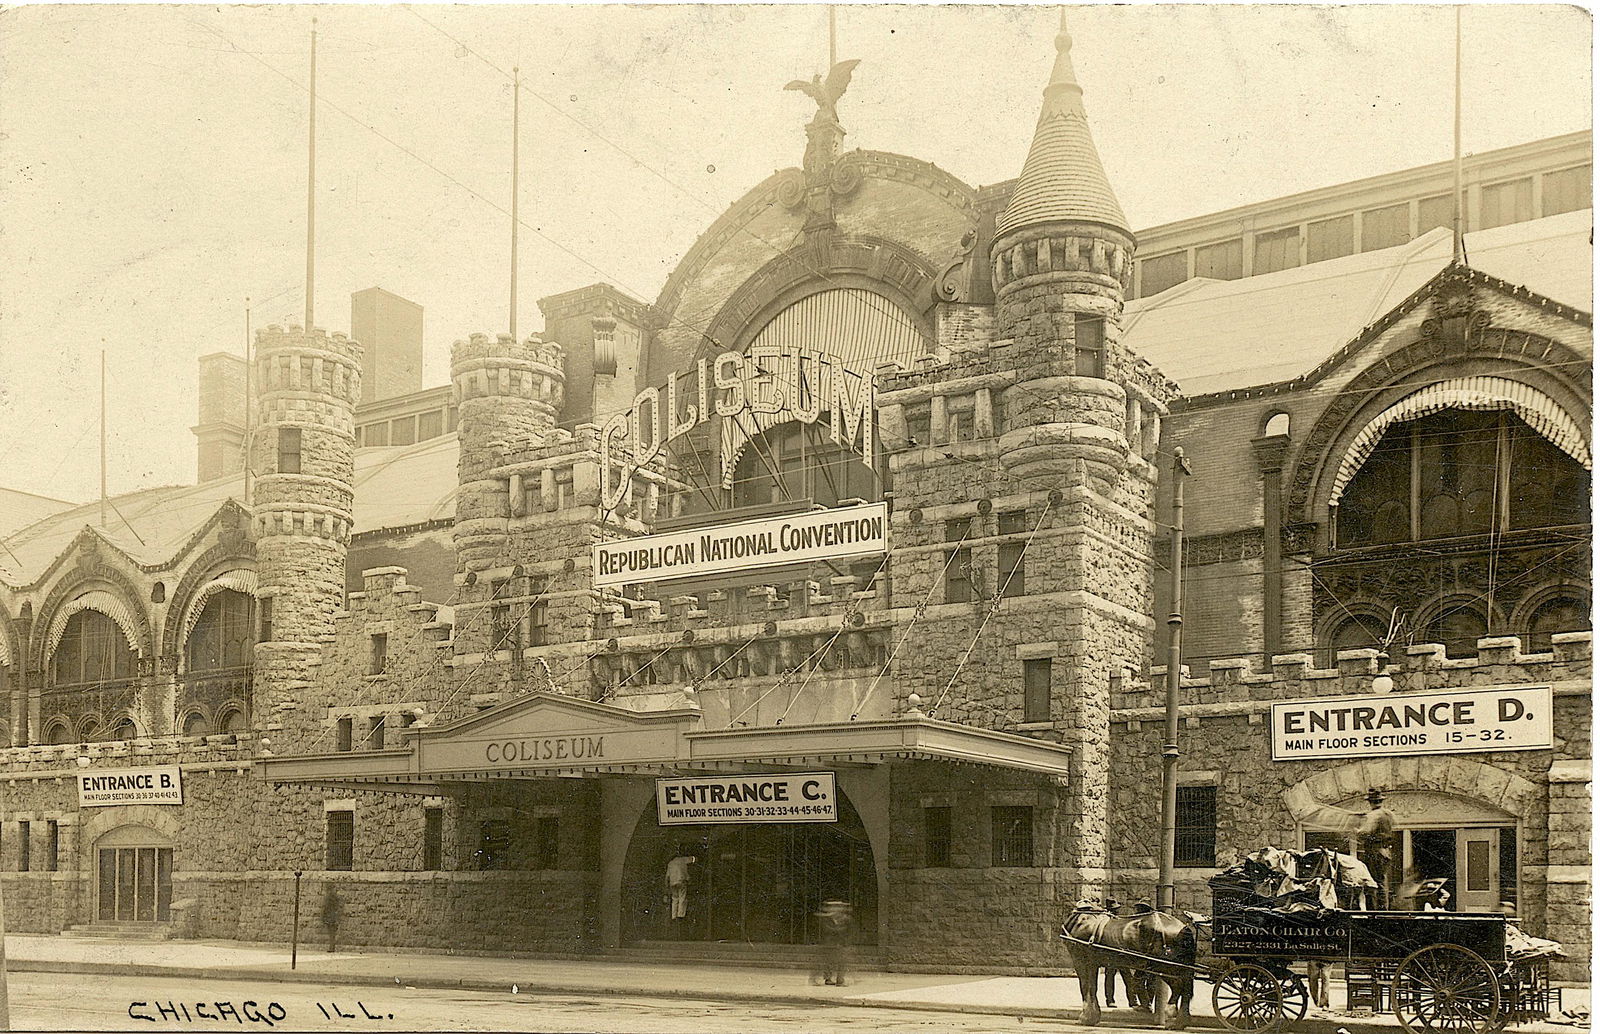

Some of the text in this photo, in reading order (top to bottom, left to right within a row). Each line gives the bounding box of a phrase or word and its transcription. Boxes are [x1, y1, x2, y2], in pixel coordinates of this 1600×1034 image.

[601, 346, 876, 511] COLISEUM
[599, 516, 882, 576] REPUBLICAN NATIONAL CONVENTION
[1283, 698, 1534, 734] ENTRANCE D.
[486, 736, 605, 763] COLISEUM
[1285, 739, 1313, 751] MAIN
[1318, 737, 1358, 750] FLOOR
[1363, 733, 1427, 747] SECTIONS
[82, 773, 175, 791] ENTRANCE B.
[95, 793, 111, 801] FLOOR
[112, 792, 135, 801] SECTIONS
[665, 780, 827, 805] ENTRANCE C.
[667, 809, 684, 818] MAIN
[685, 808, 706, 818] FLOOR
[708, 807, 743, 818] SECTIONS
[1221, 924, 1270, 936] EATON
[1272, 925, 1321, 937] CHAIR
[1299, 942, 1326, 950] Salle
